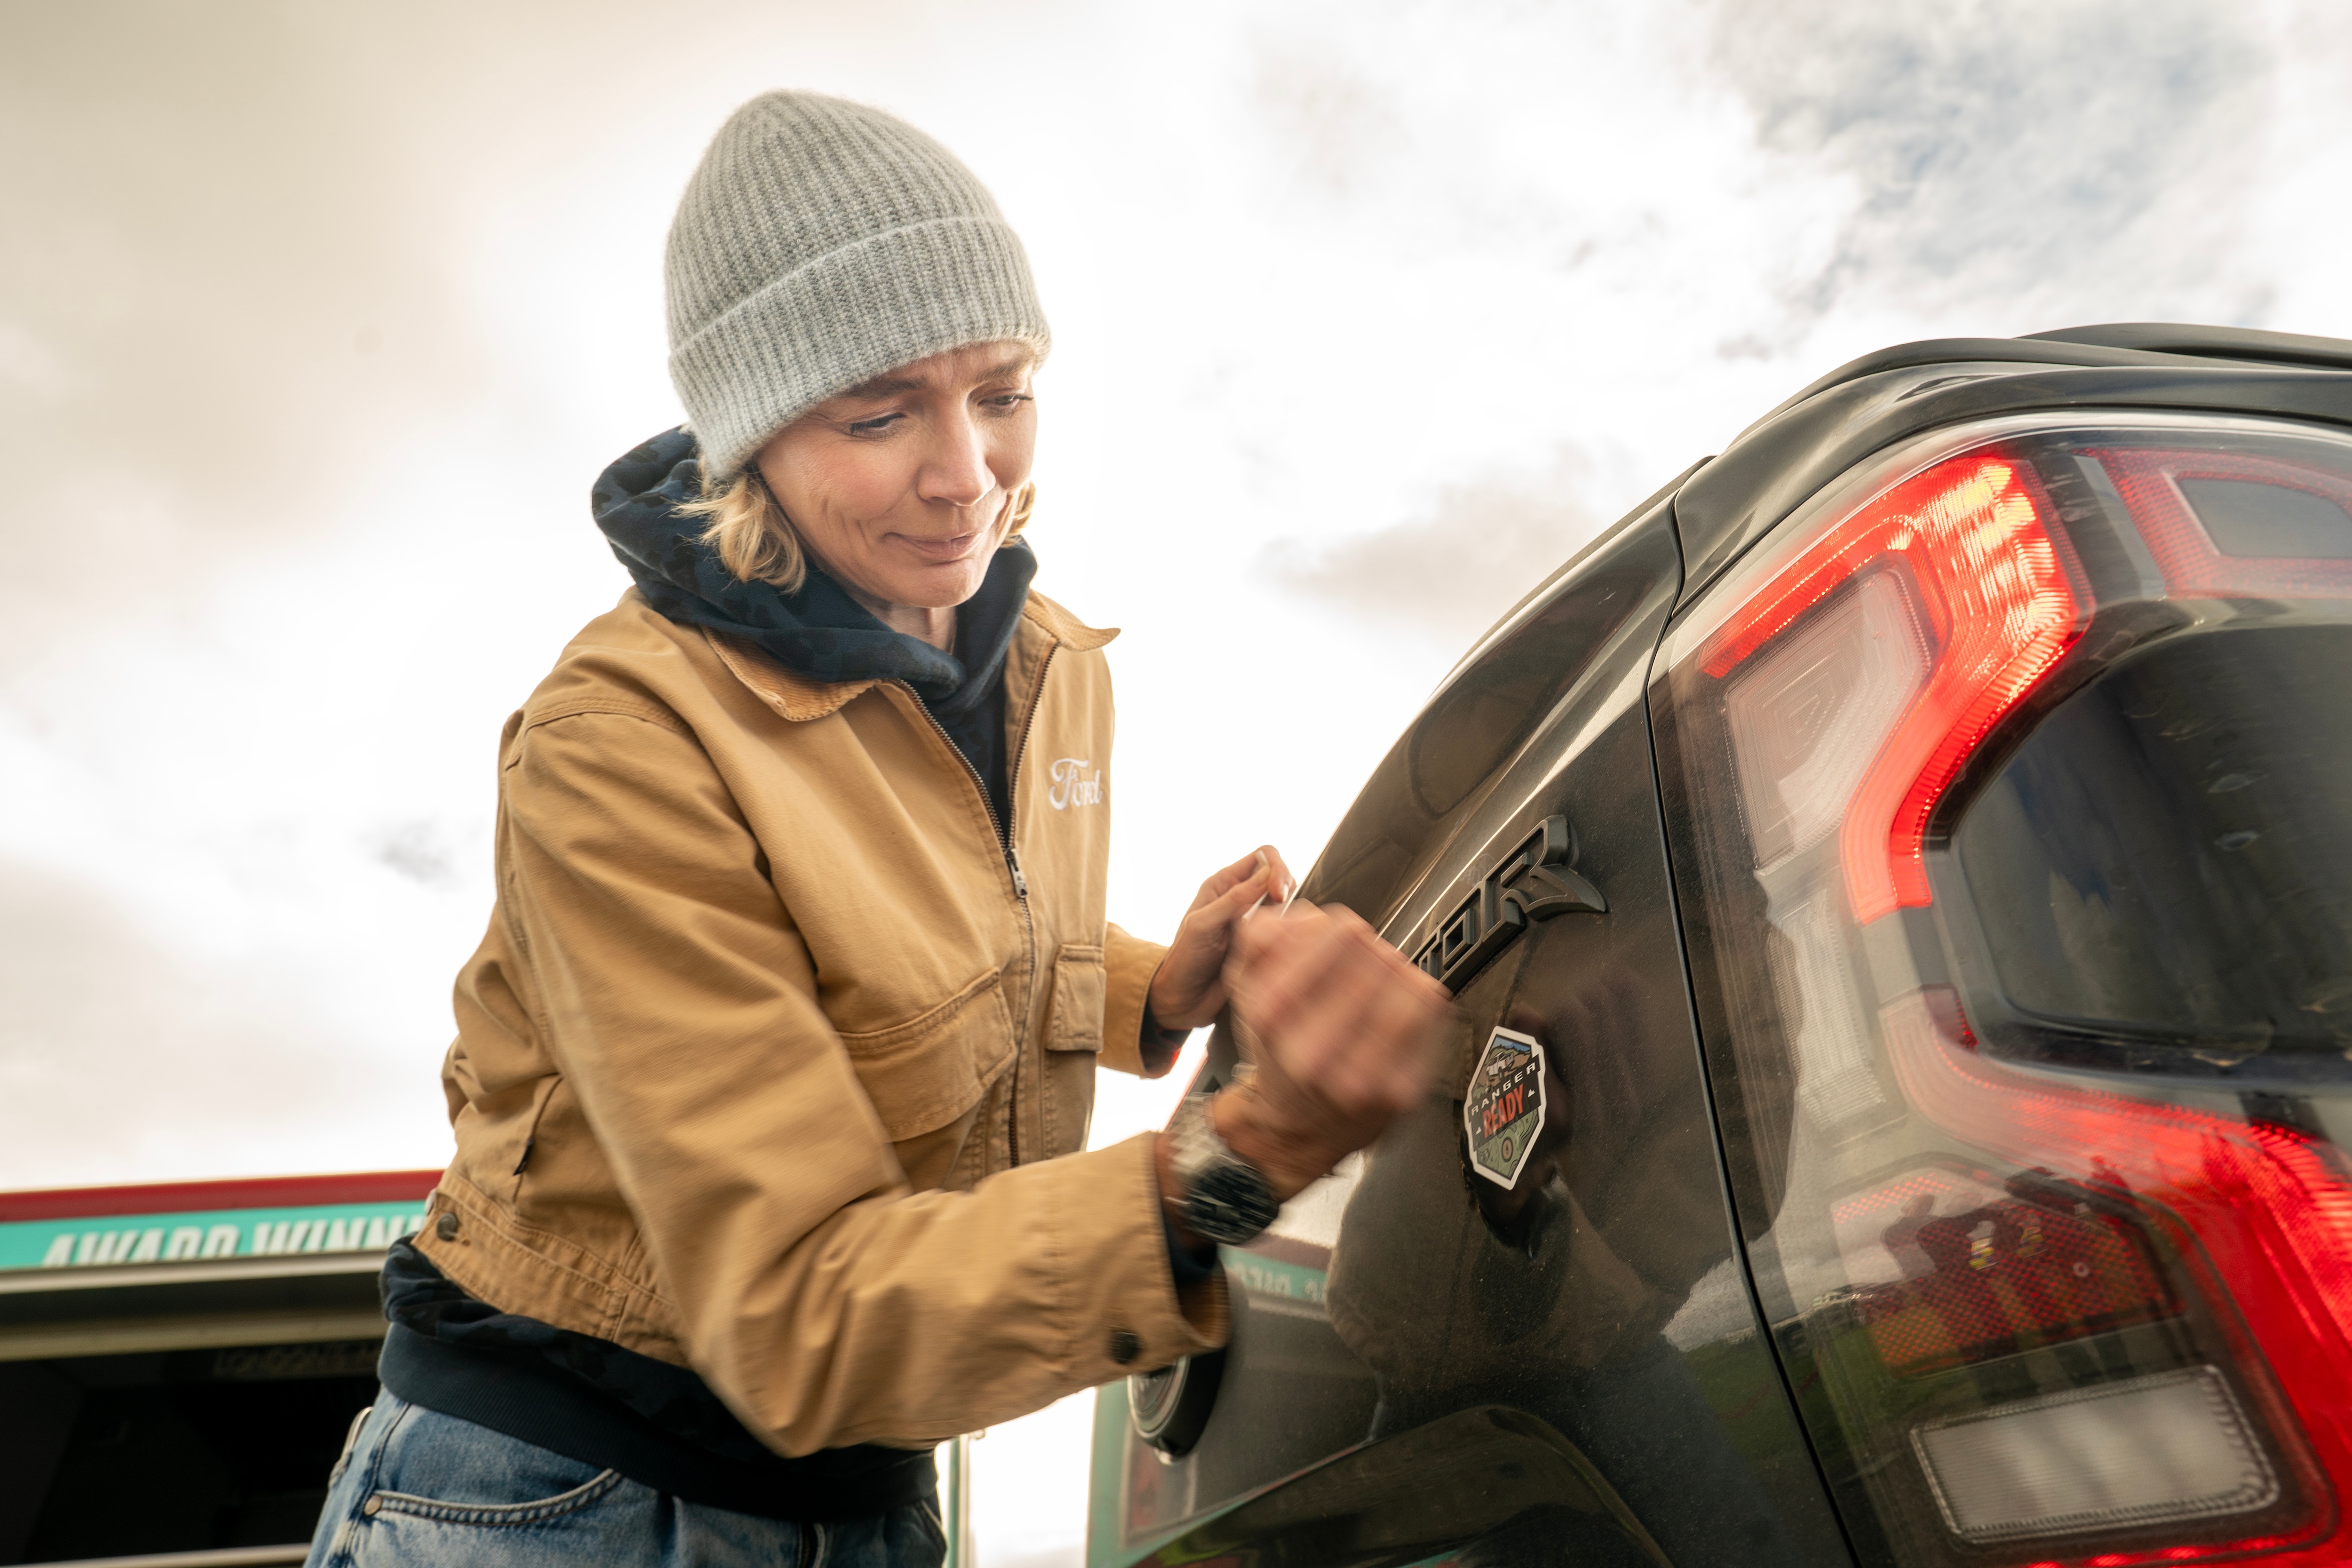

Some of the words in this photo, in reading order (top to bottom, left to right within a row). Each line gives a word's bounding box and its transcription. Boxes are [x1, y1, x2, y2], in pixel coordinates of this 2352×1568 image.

[1049, 758, 1104, 811] Ford
[1471, 1062, 1536, 1116] RANGER
[1483, 1083, 1524, 1138] READY
